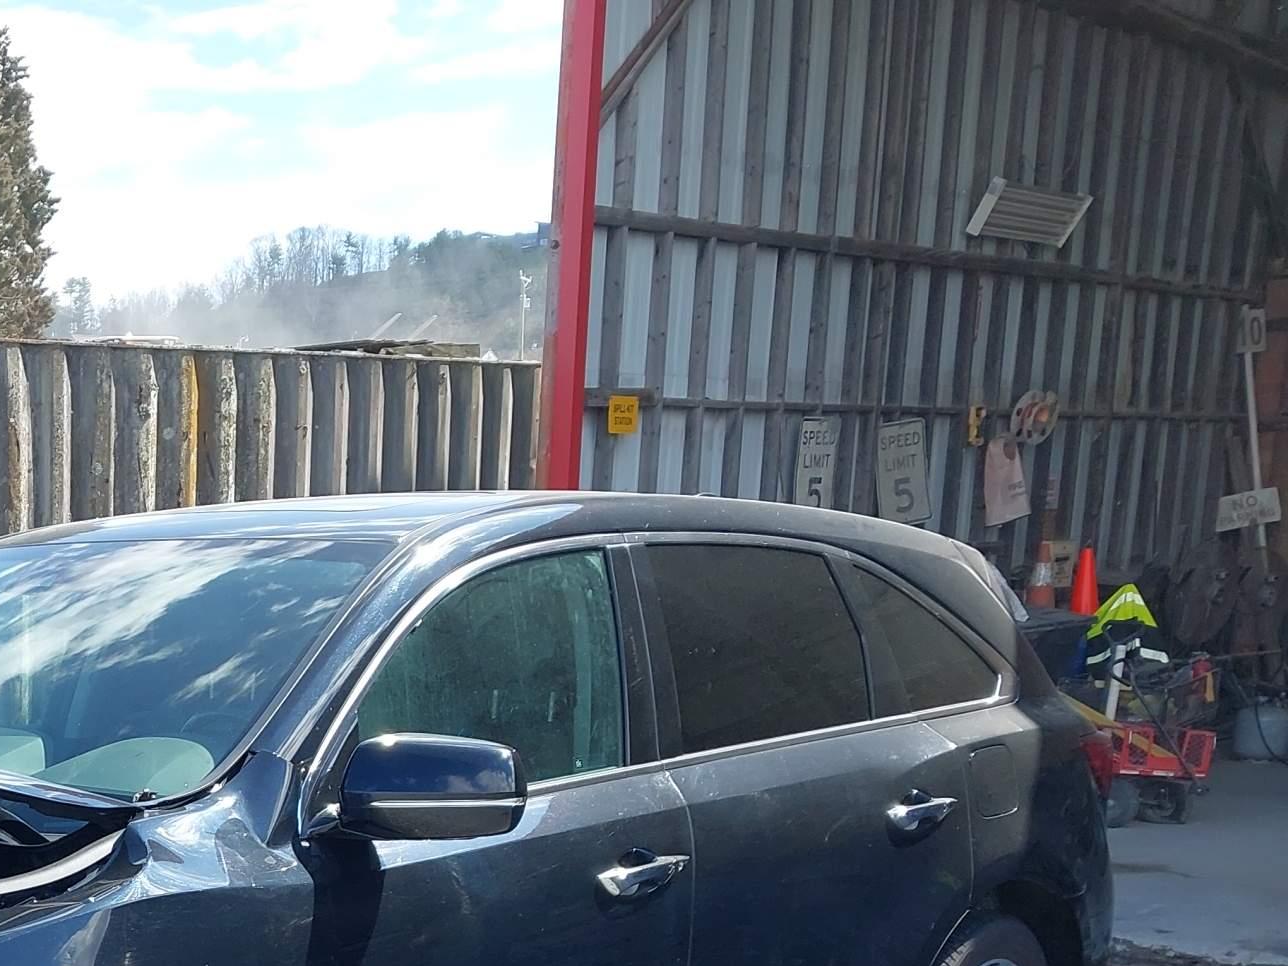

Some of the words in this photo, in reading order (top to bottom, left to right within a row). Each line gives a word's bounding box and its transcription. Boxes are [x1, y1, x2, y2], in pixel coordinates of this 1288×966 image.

[802, 430, 836, 446] SPEED
[879, 431, 921, 451] SPEED
[803, 454, 831, 469] LIMIT
[885, 454, 917, 472] LIMIT
[808, 477, 822, 507] 5
[894, 477, 915, 513] 5
[1232, 495, 1258, 511] NO
